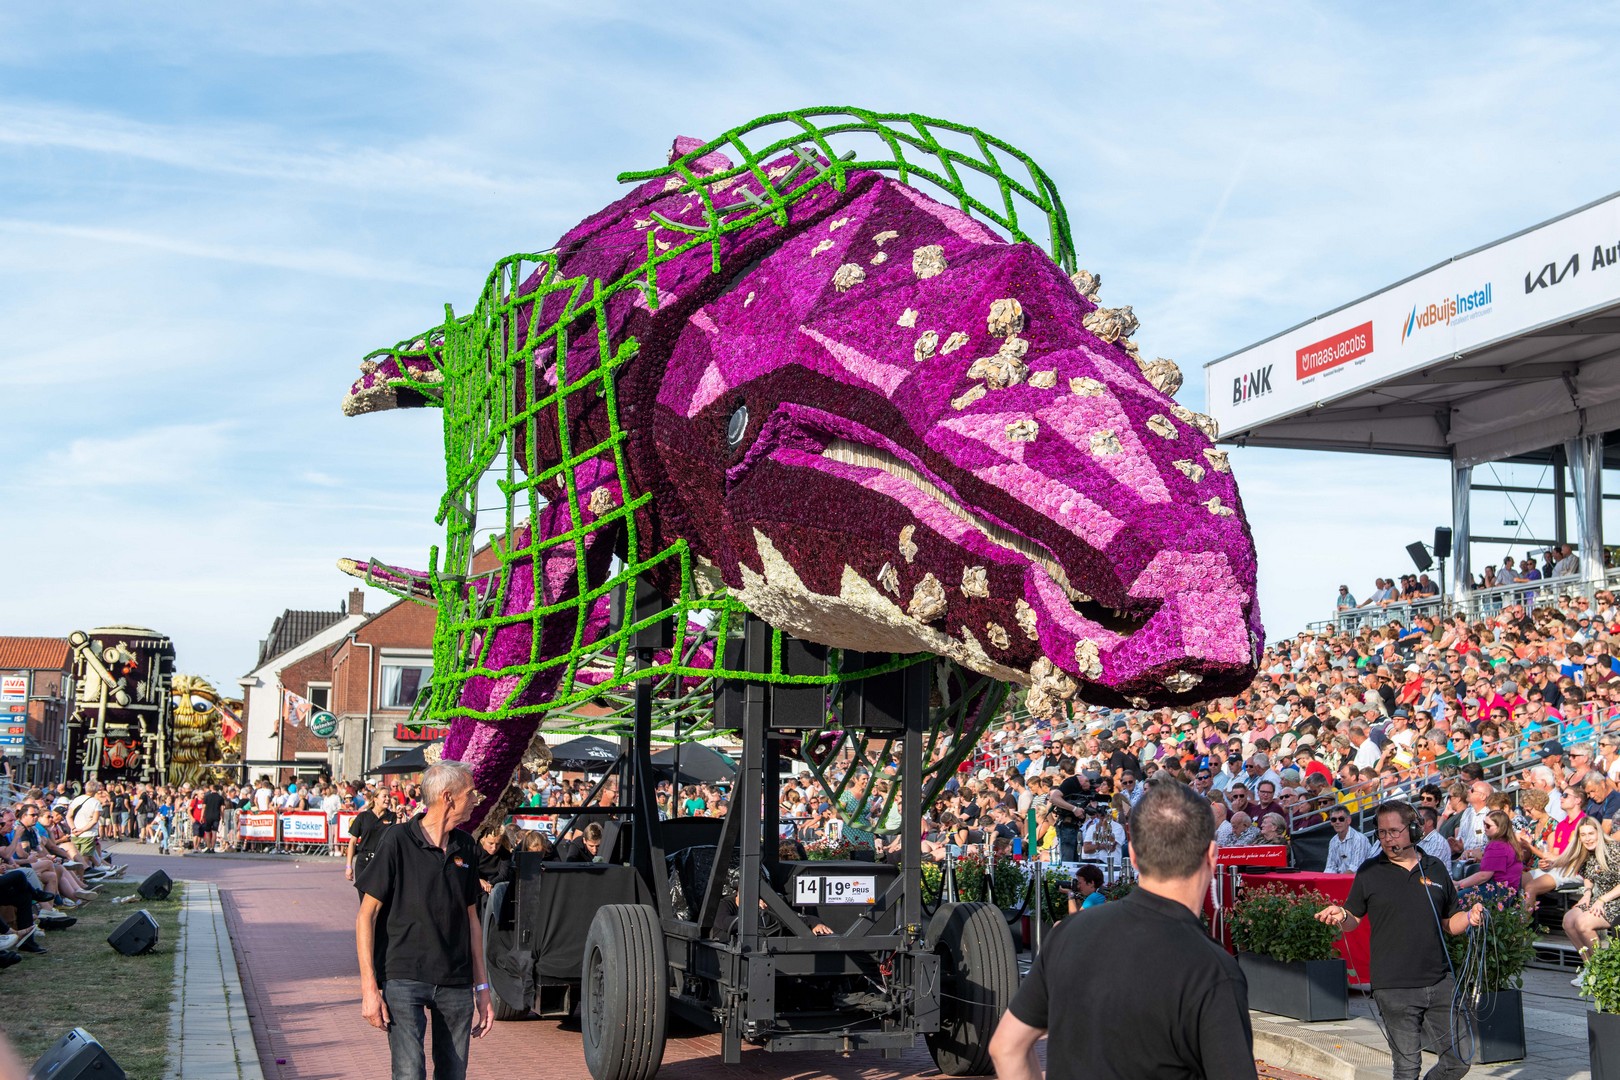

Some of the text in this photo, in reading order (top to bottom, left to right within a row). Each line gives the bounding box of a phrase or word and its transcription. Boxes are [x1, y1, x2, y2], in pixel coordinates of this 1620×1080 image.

[3, 679, 25, 687] AVIA
[312, 719, 336, 731] Heineken
[798, 880, 817, 893] 14
[826, 882, 850, 895] 19e
